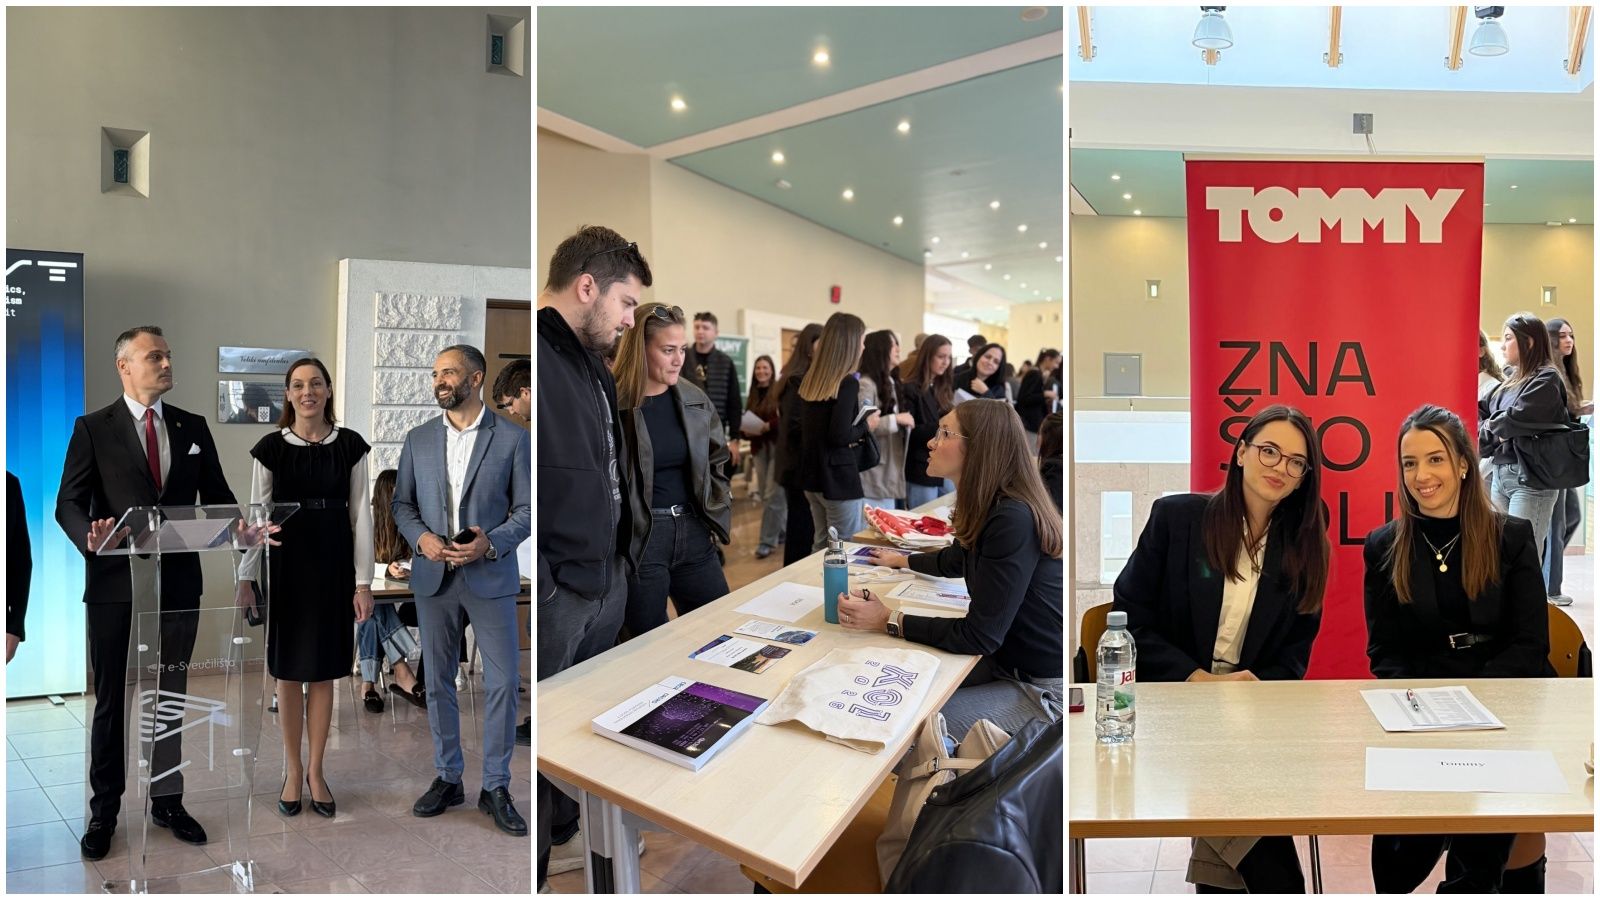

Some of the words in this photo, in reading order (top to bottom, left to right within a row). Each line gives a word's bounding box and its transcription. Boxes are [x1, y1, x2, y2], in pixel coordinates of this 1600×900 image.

[1206, 186, 1465, 244] TOMMY
[1218, 341, 1377, 397] ZNA
[1219, 396, 1372, 472] ŠO
